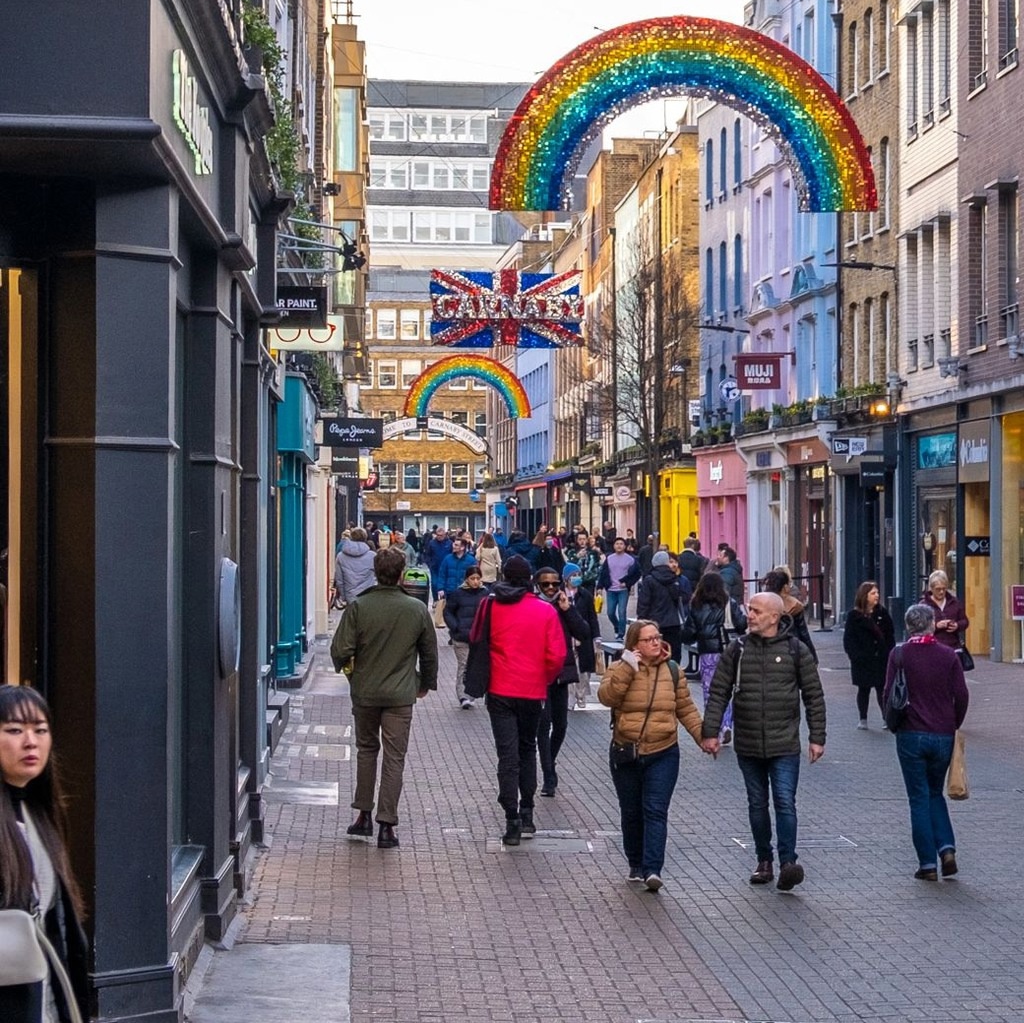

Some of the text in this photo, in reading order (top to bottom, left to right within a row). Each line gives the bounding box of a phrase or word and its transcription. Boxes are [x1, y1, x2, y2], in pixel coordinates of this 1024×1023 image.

[287, 299, 317, 308] PAINT.
[436, 294, 584, 320] CARNABY
[744, 364, 773, 377] MUJI
[329, 423, 376, 437] Pepe Jeans
